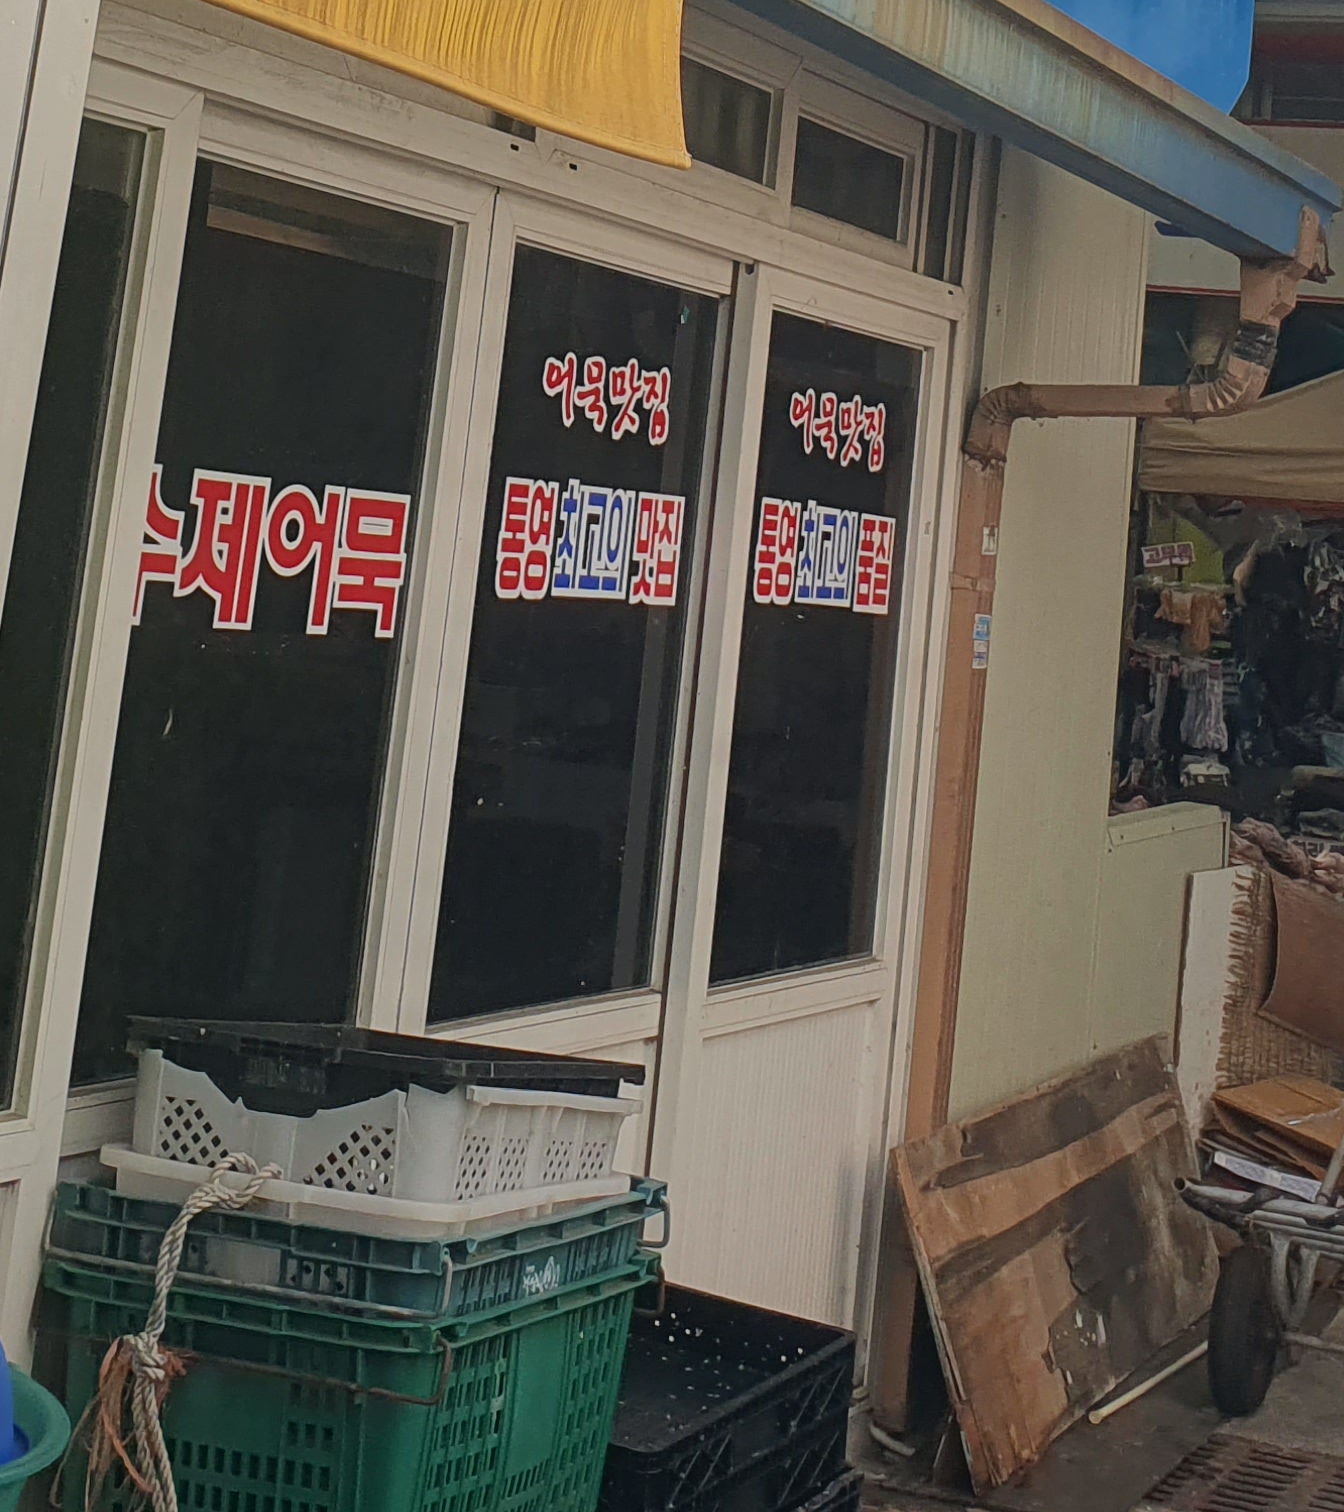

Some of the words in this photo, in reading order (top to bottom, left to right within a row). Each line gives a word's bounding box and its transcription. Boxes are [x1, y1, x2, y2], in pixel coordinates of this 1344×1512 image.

[542, 351, 671, 446] 어묵맛집
[789, 387, 887, 472] 어묵맛집
[495, 476, 560, 600] 통영
[551, 478, 636, 600] 최고의
[628, 491, 686, 606] 맛집
[753, 496, 802, 606] 통영
[794, 499, 859, 608] 최고의
[852, 512, 897, 615] 품질
